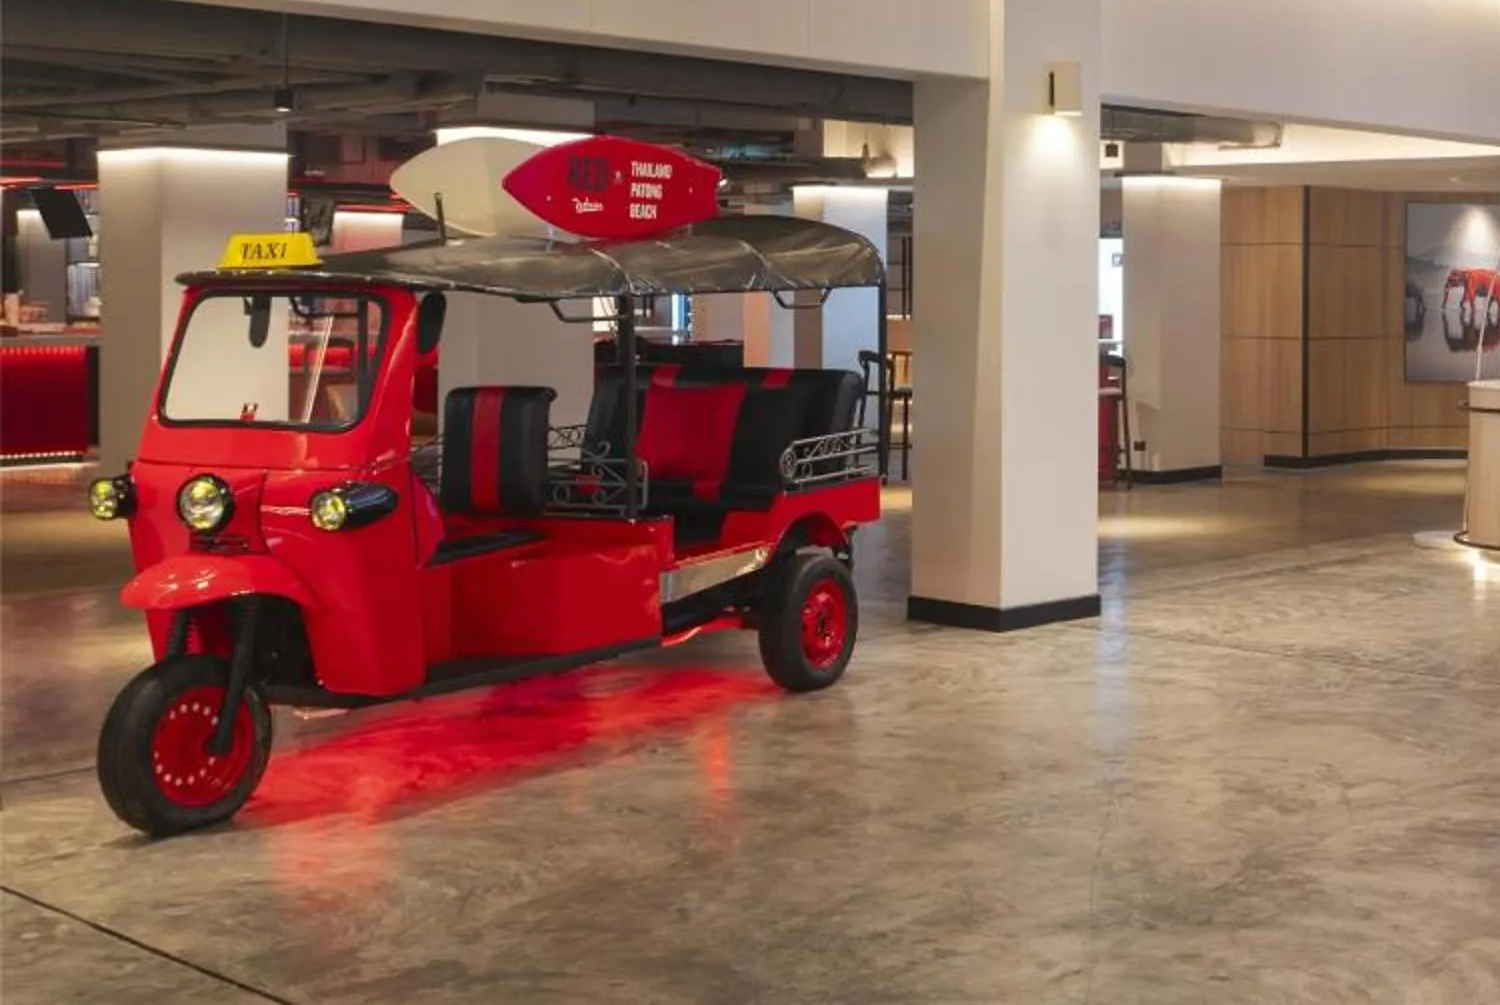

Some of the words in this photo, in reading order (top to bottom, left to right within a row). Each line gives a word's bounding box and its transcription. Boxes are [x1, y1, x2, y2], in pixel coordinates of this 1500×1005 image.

[568, 156, 609, 192] RED
[630, 160, 673, 179] THAILAND
[630, 182, 663, 200] PATONG
[629, 203, 657, 219] BEACH
[241, 242, 289, 260] TAXI
